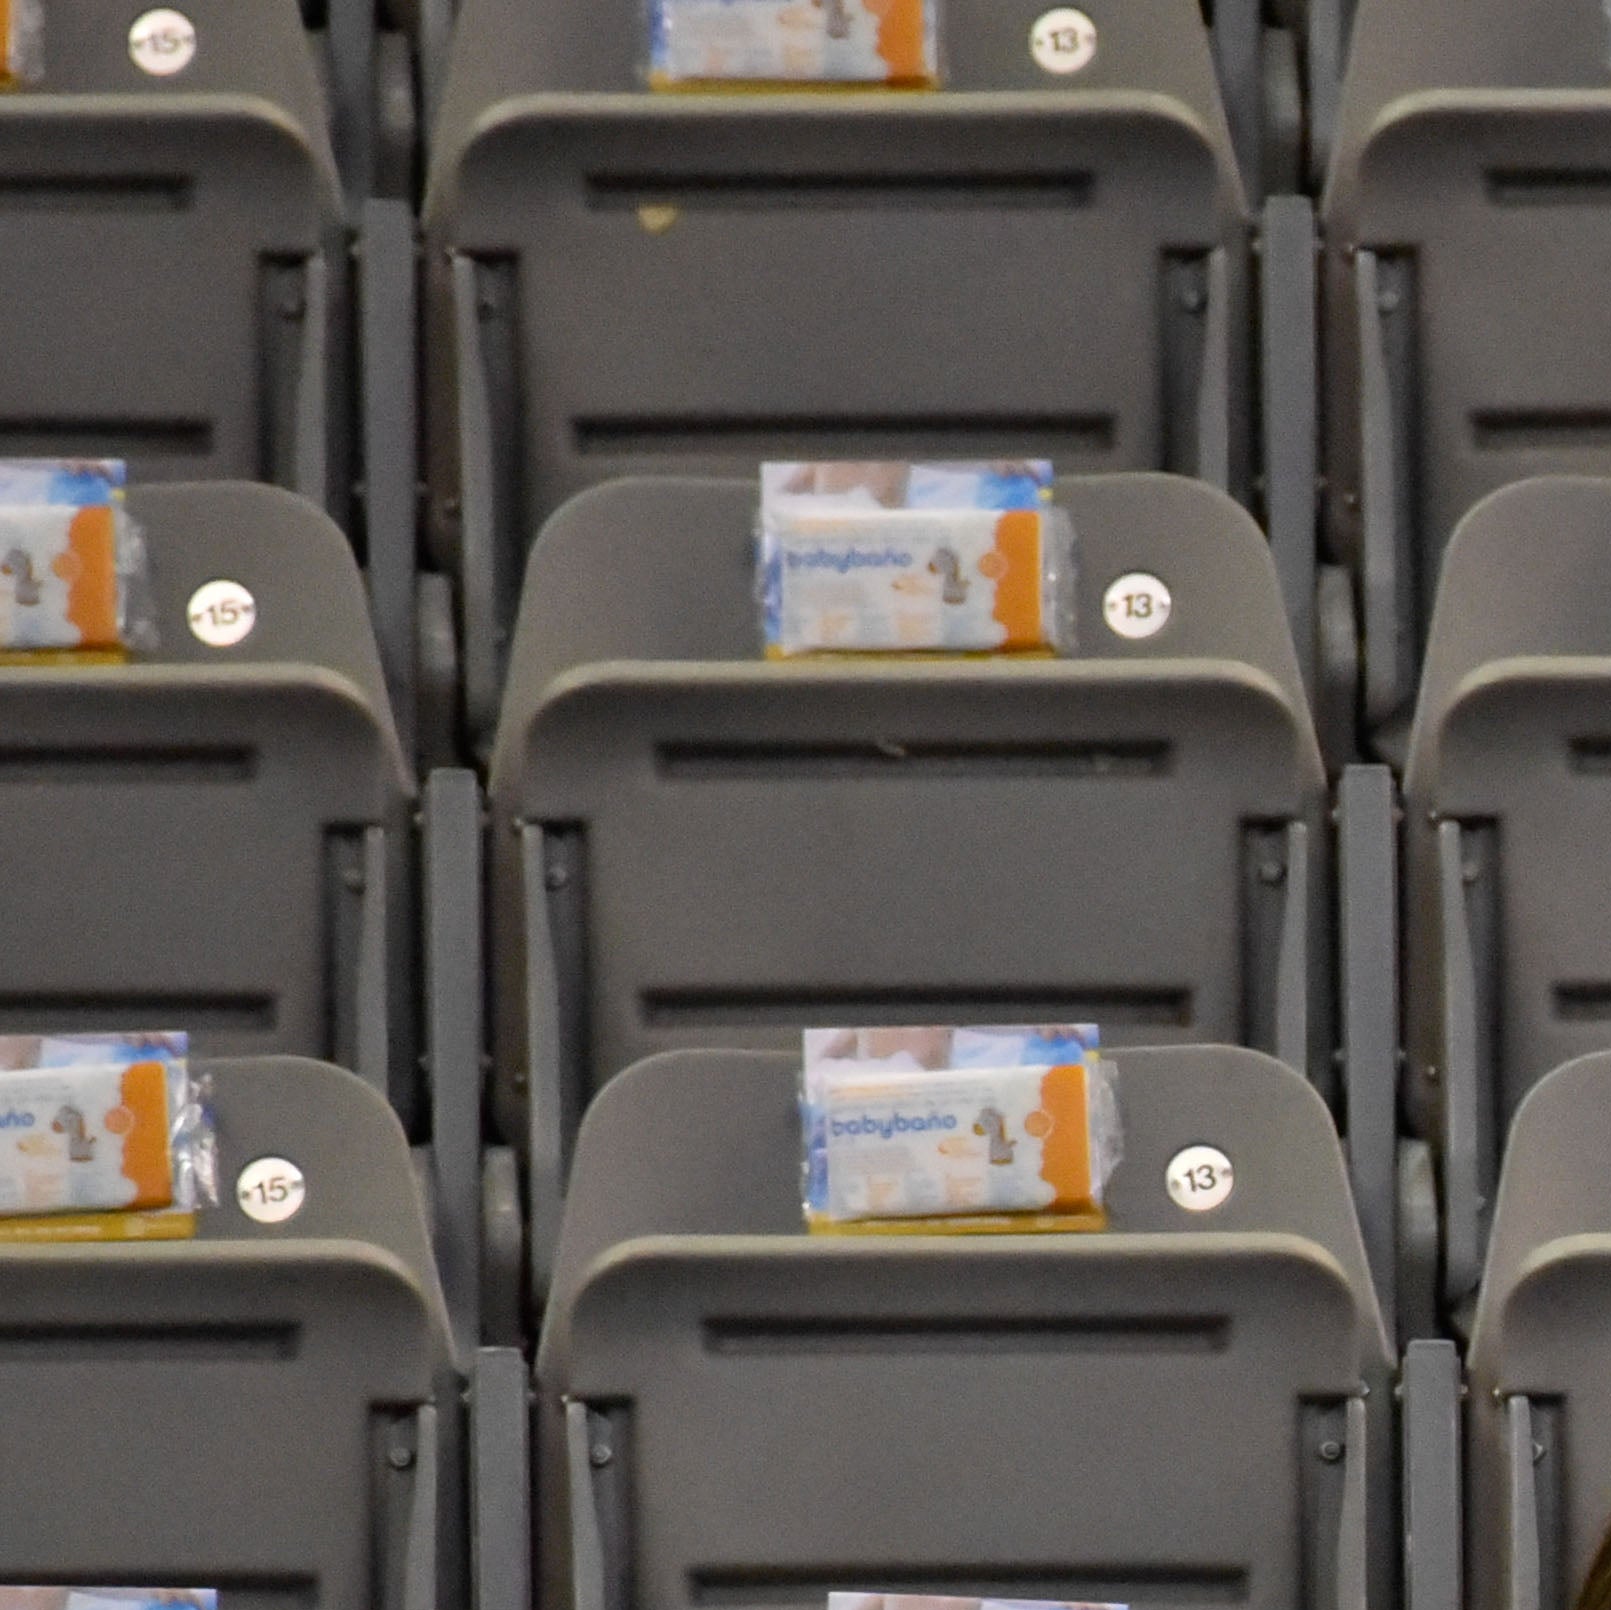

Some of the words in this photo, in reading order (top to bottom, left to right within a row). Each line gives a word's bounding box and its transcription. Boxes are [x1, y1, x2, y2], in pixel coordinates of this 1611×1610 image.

[1050, 27, 1079, 53] 13
[207, 601, 238, 626] 15
[1124, 592, 1153, 617] 13
[831, 1112, 957, 1139] babybaño
[256, 1175, 289, 1204] 15
[1183, 1164, 1216, 1192] 13
